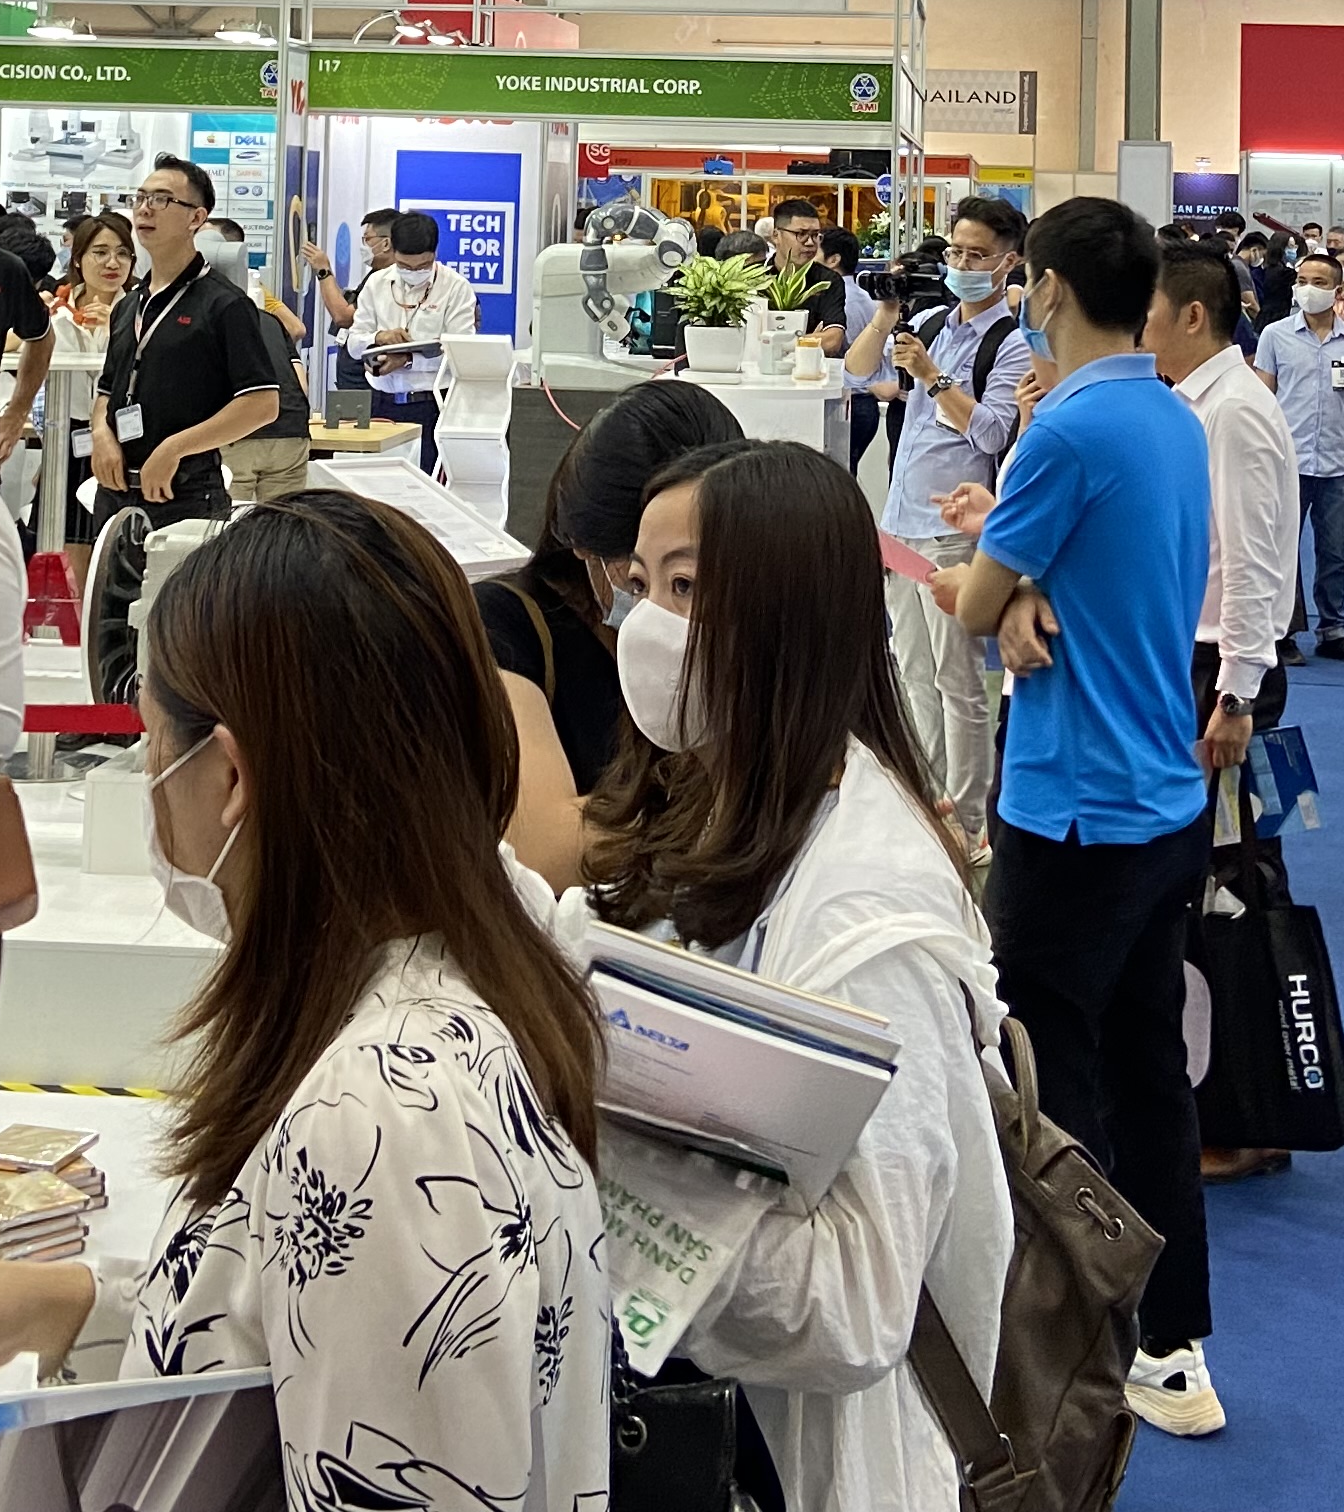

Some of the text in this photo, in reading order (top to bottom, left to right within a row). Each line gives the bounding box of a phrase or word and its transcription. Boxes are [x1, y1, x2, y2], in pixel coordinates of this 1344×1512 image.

[59, 67, 92, 83] CO.,
[96, 67, 131, 81] LTD.
[496, 75, 703, 95] YOKE INDUSTRIAL CORP.
[925, 89, 1017, 104] AILAND
[850, 101, 879, 113] TAMI
[235, 135, 267, 146] DELL
[446, 214, 501, 233] TECH
[459, 238, 501, 257] FOR
[1288, 974, 1324, 1089] HURCO
[629, 1231, 697, 1286] DANH
